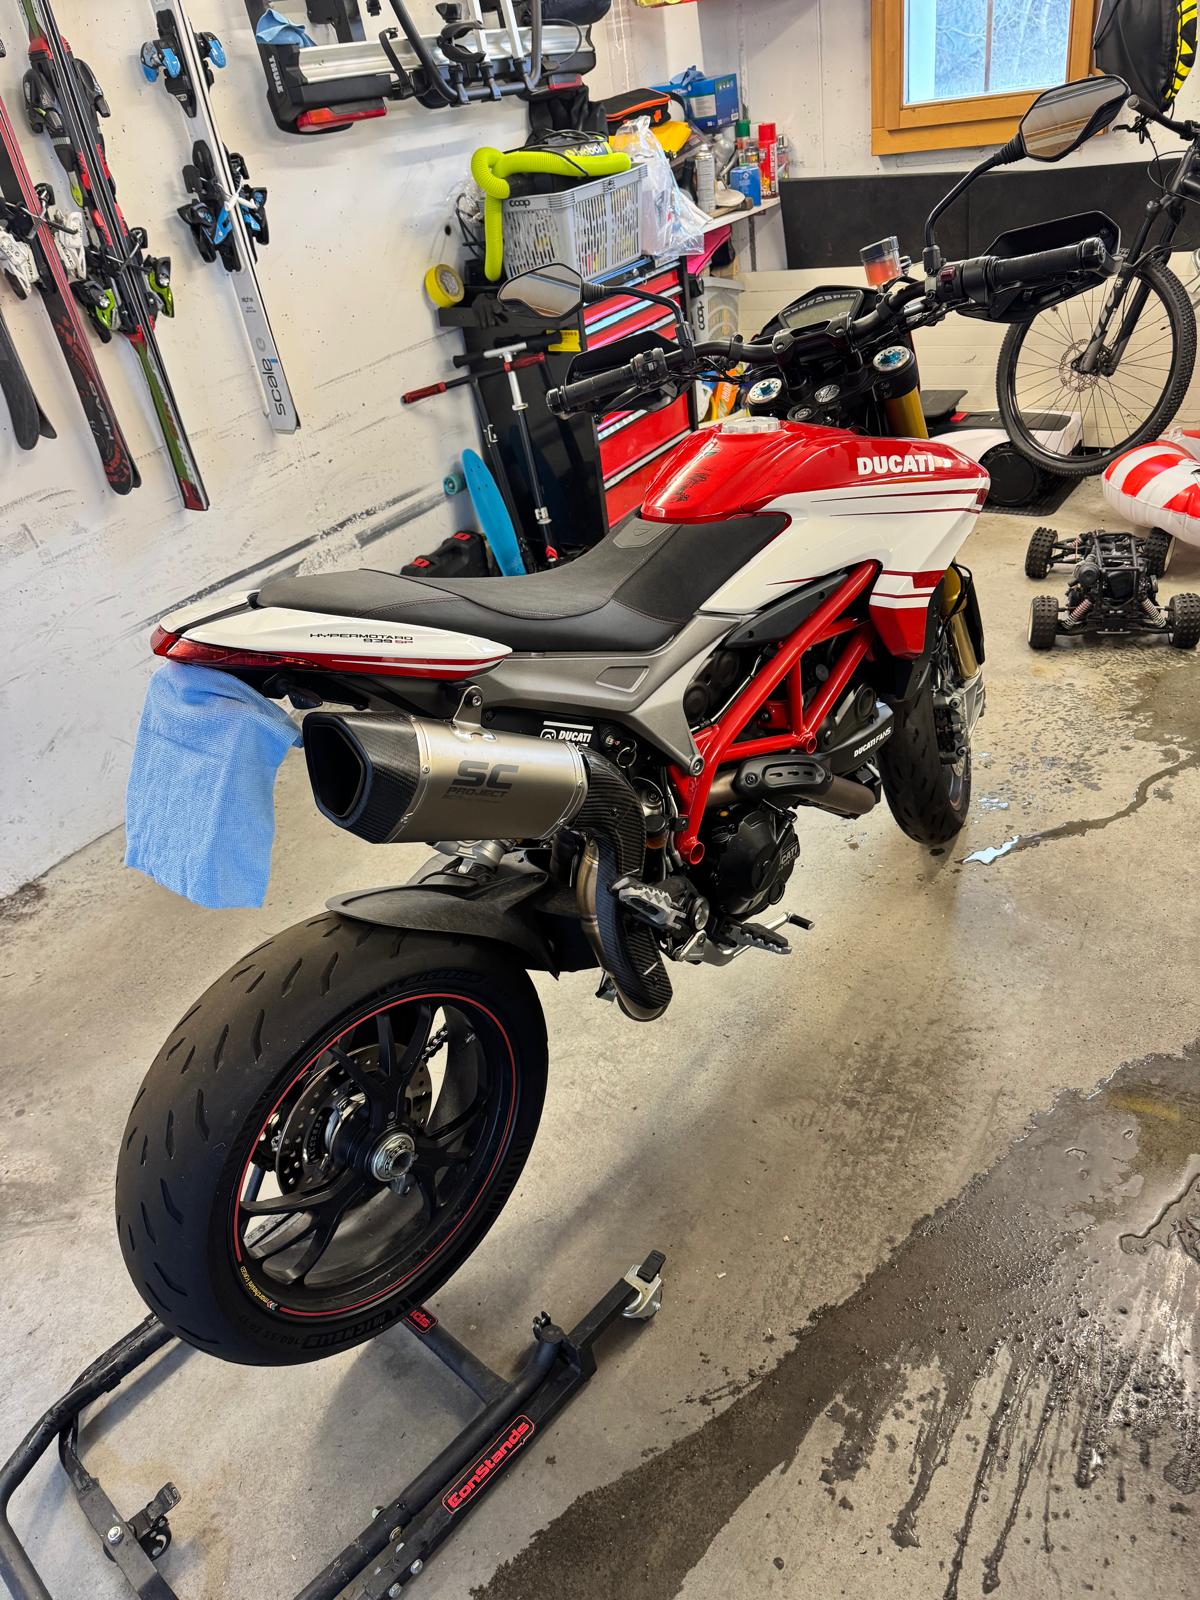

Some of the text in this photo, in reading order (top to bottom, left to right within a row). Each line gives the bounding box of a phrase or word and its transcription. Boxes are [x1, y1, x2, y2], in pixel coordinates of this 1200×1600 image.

[268, 55, 284, 94] THULE
[509, 199, 531, 208] coop
[697, 300, 706, 330] coop
[89, 380, 115, 440] HEAD
[856, 455, 935, 475] DUCATI
[558, 730, 592, 743] DUCATI
[450, 760, 519, 790] SC
[445, 786, 509, 799] PROJECT
